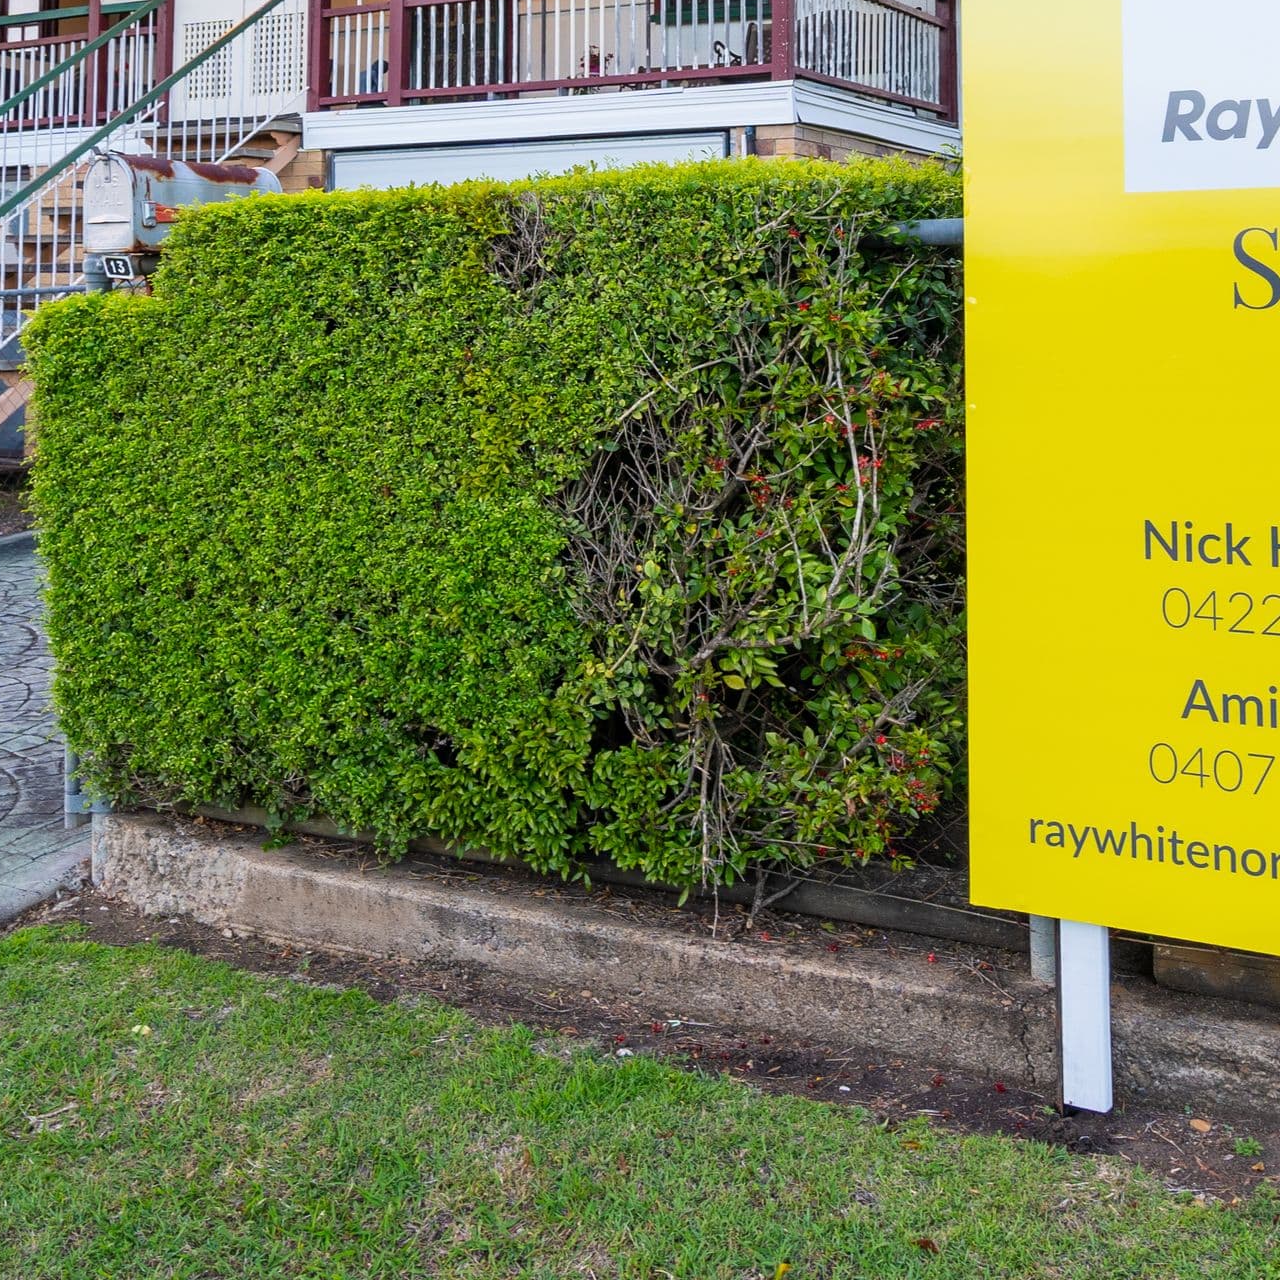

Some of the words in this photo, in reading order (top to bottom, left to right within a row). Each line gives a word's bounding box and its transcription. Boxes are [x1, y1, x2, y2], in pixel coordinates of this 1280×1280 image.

[110, 260, 125, 274] 13
[1144, 519, 1252, 568] Nick
[1149, 742, 1276, 795] 0407
